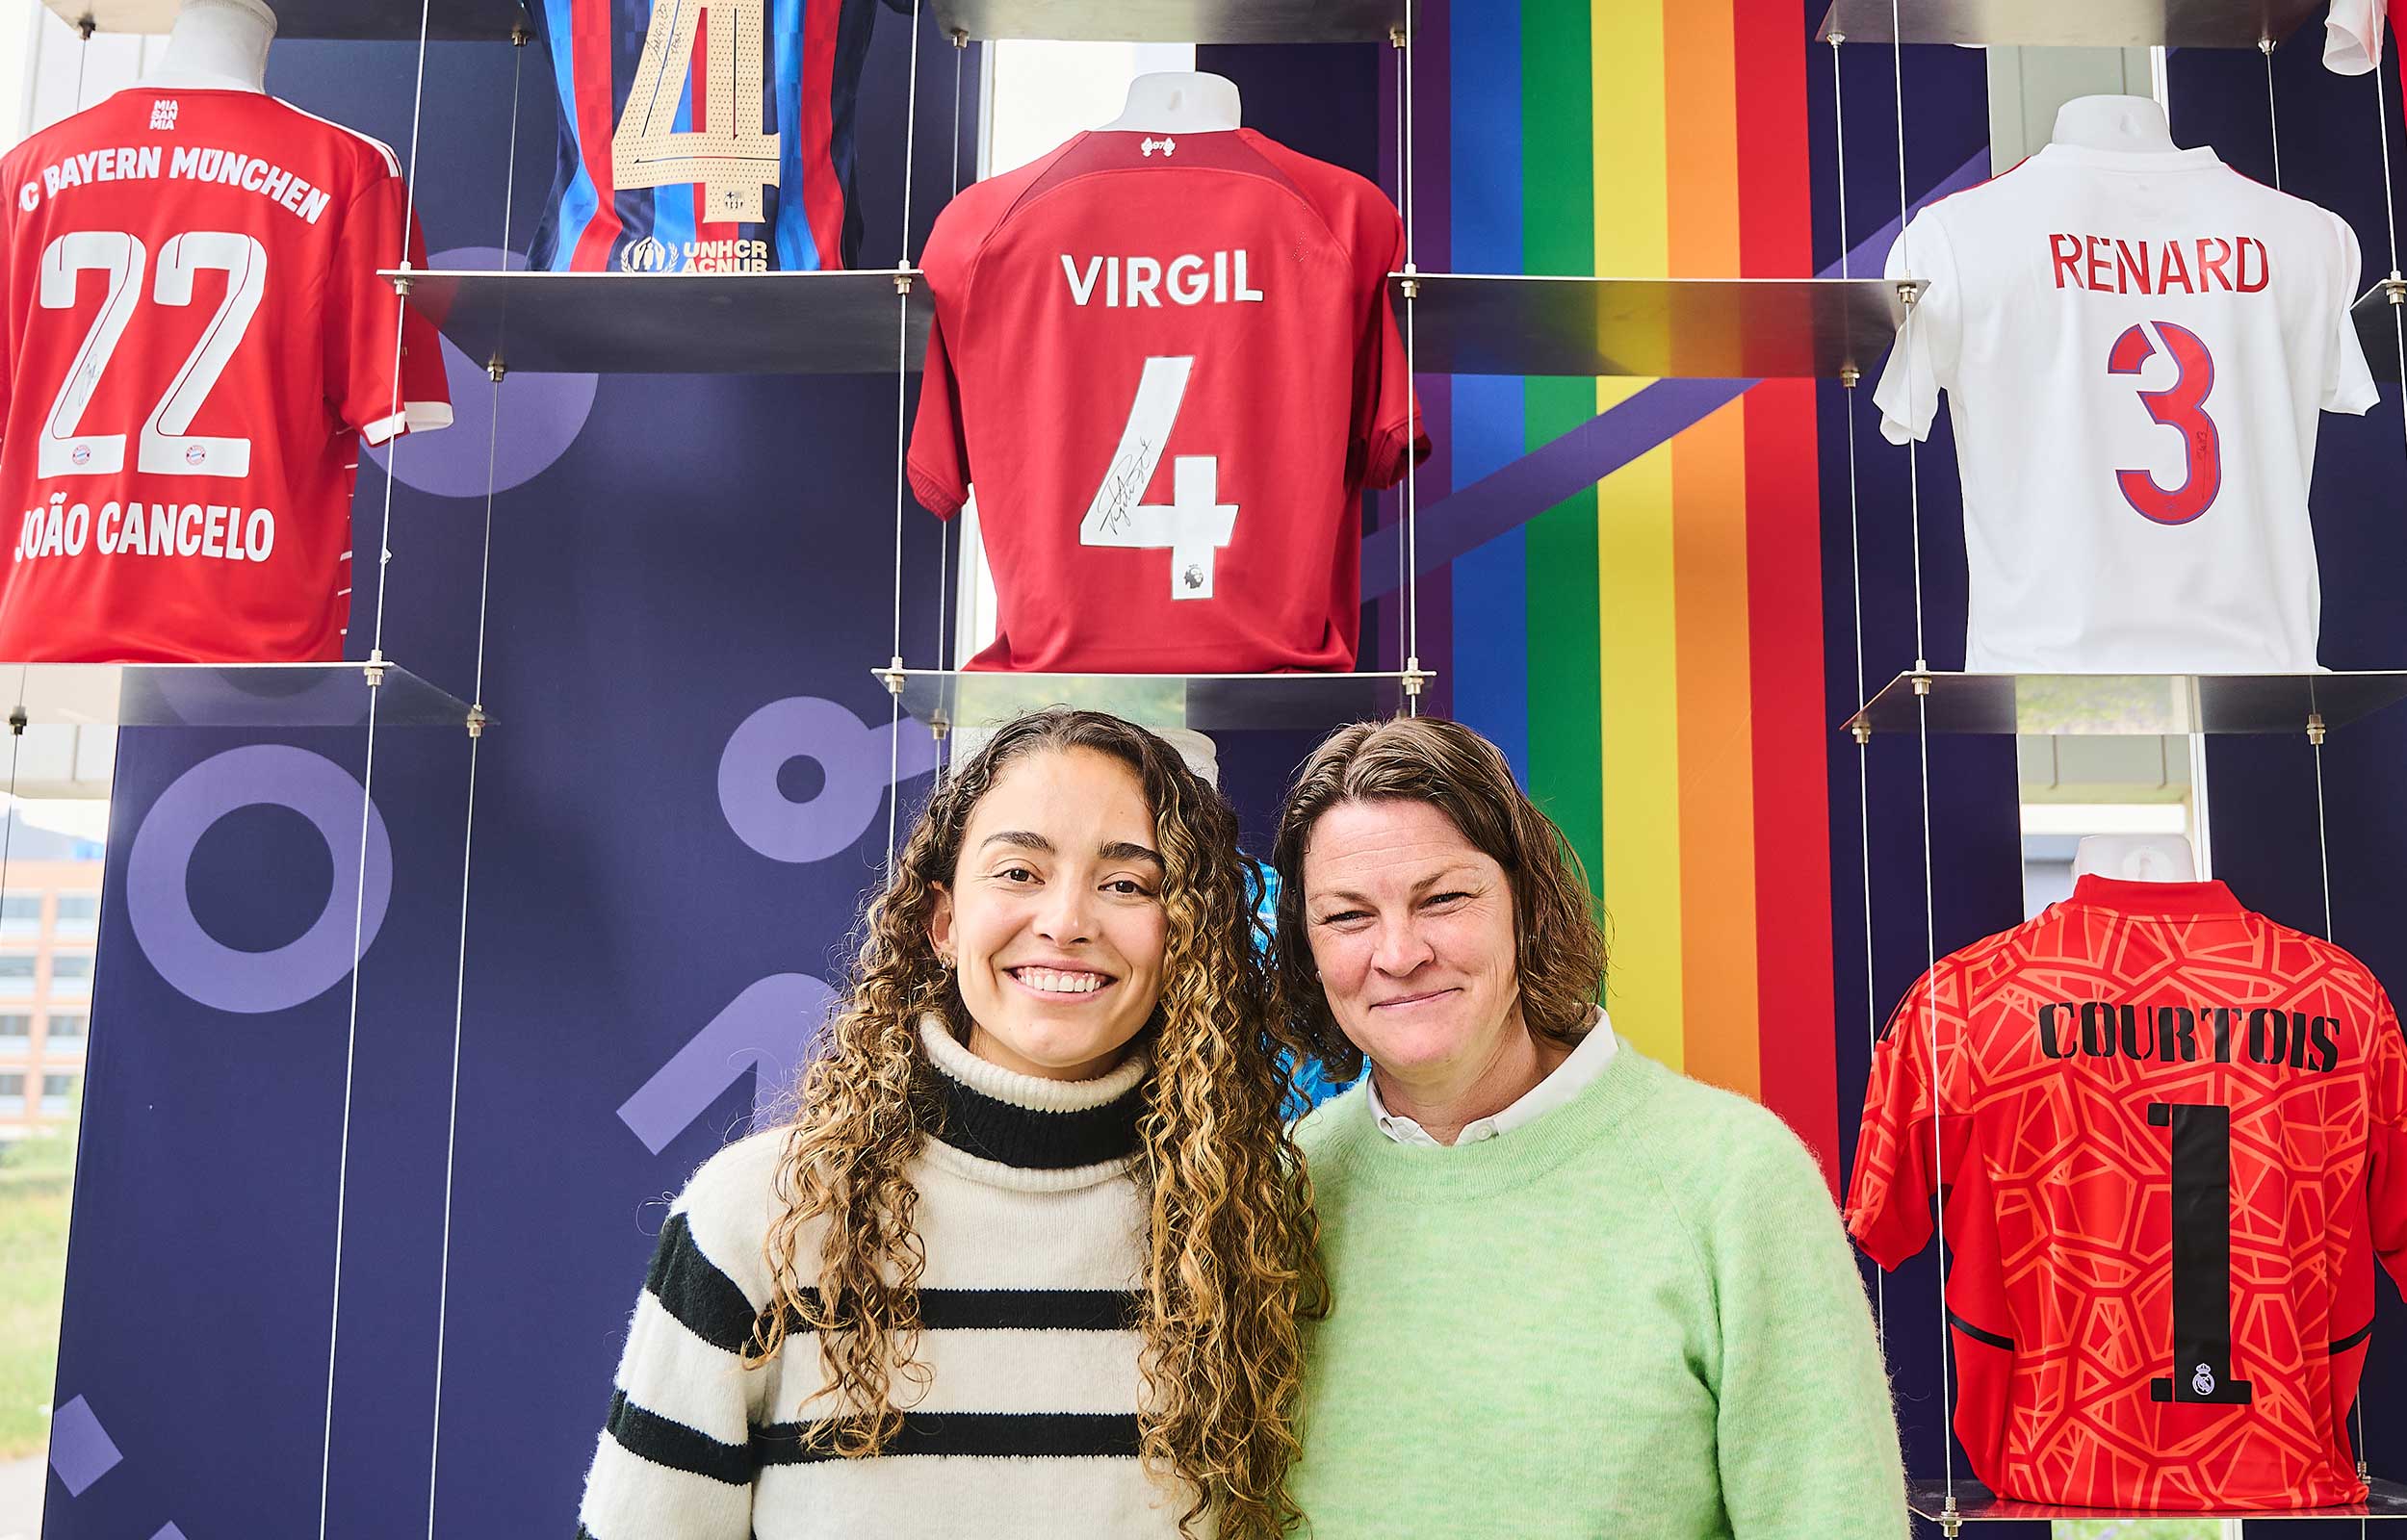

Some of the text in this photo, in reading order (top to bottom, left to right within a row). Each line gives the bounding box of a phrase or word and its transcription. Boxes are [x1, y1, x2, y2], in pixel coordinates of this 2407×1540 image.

[148, 119, 175, 131] MIA
[150, 110, 178, 121] SAN
[153, 99, 179, 111] MIA
[611, 0, 781, 224] 4
[18, 146, 331, 225] C BAYERN MÜNCHEN
[683, 239, 768, 259] UNHCR
[1060, 249, 1264, 308] VIRGIL
[2048, 232, 2270, 295] RENARD
[37, 230, 269, 480] 22
[2107, 320, 2222, 526] 3
[1079, 355, 1241, 601] 4
[14, 492, 275, 563] JOÃO CANCELO
[2038, 1001, 2341, 1073] COURTOIS
[2147, 1102, 2252, 1404] 1
